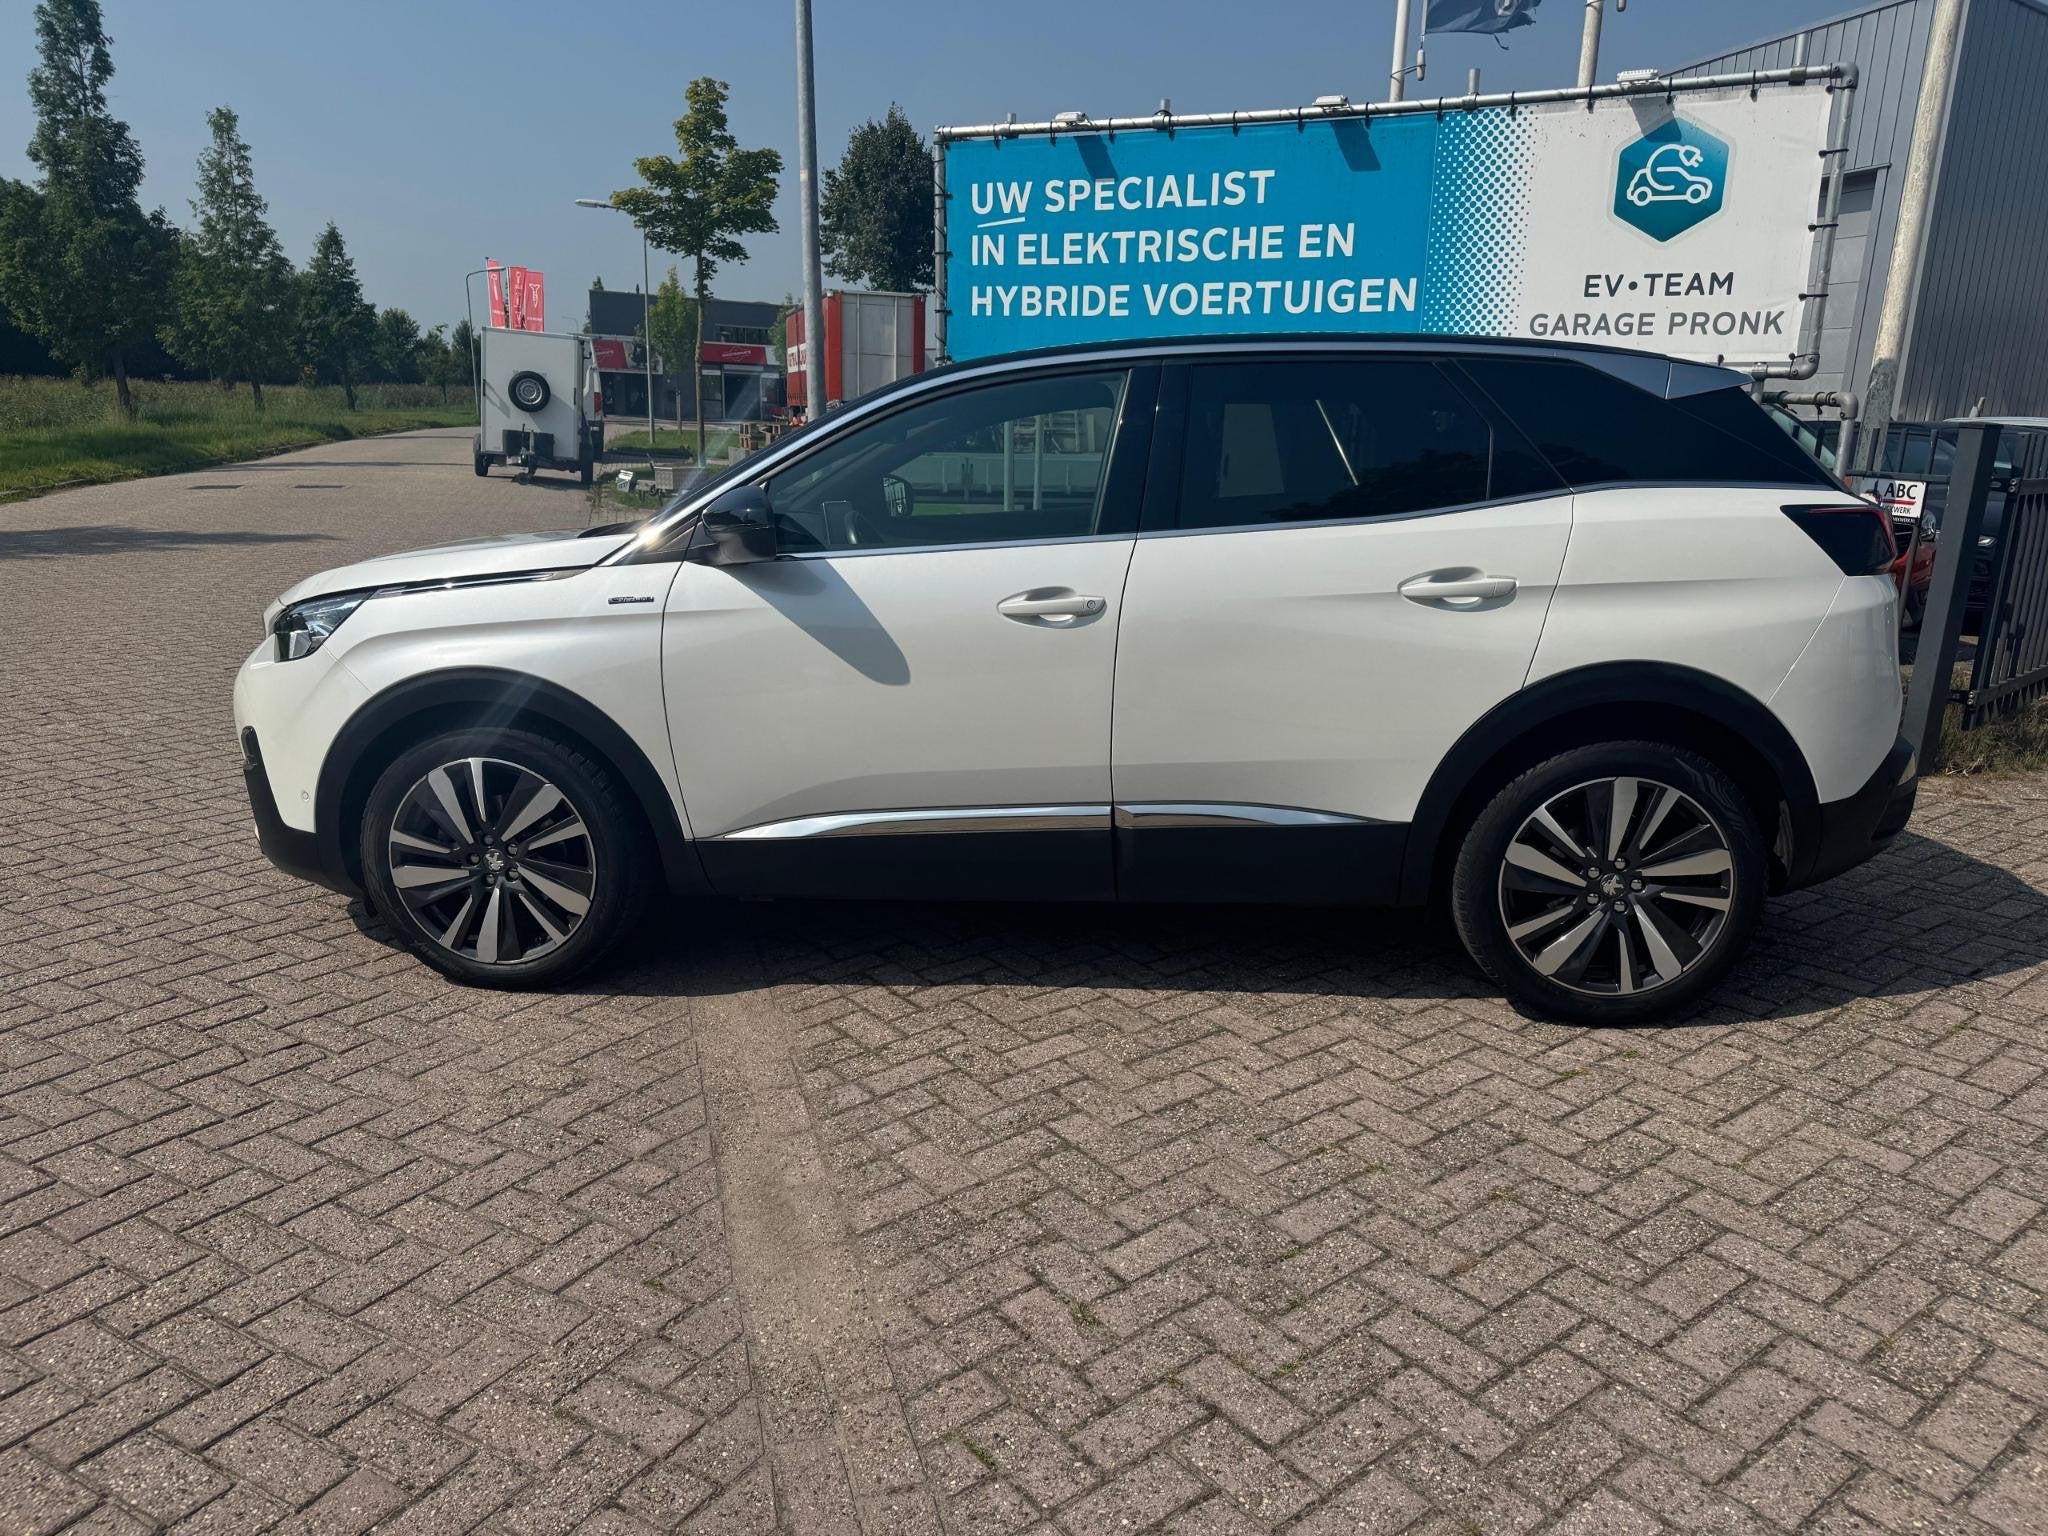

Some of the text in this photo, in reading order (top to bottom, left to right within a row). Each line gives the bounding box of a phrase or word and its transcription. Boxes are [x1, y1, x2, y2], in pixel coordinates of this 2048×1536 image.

[971, 169, 1276, 215] UW SPECIALIST
[971, 222, 1355, 266] IN ELEKTRISCHE EN
[971, 277, 1418, 317] HYBRIDE VOERTUIGEN
[1529, 310, 1786, 337] GARAGE PRONK
[1884, 482, 1918, 499] ABC
